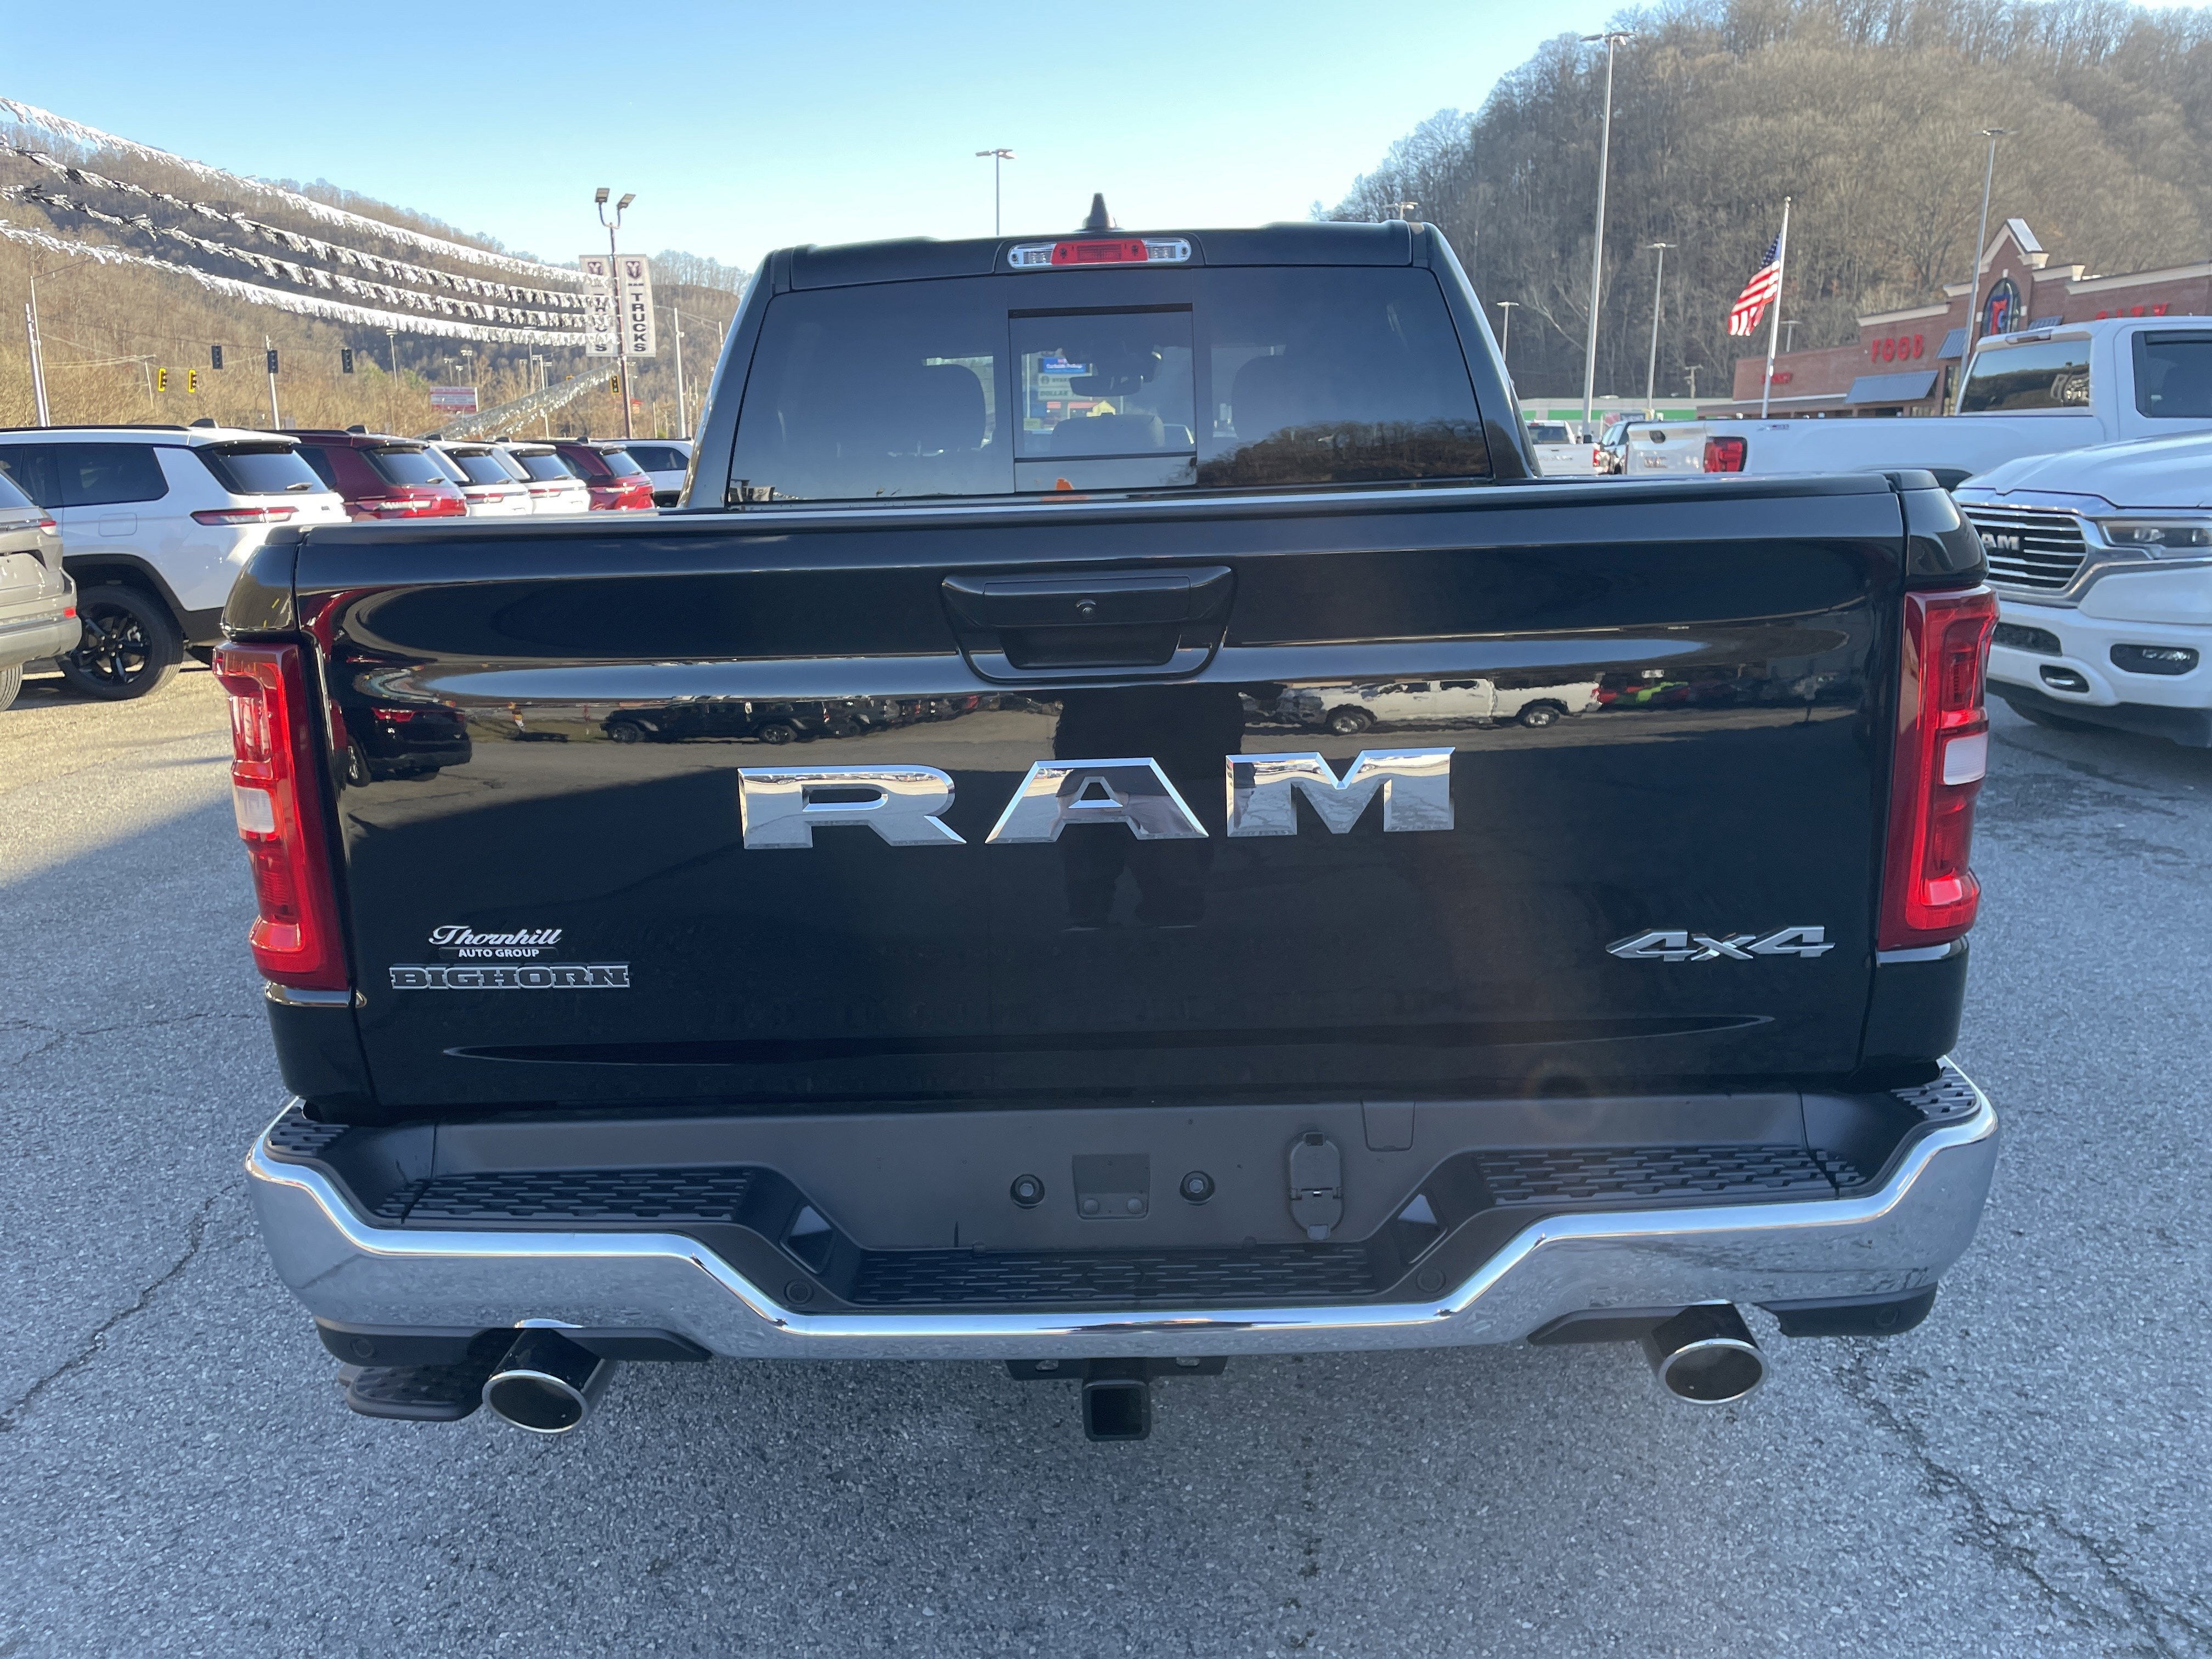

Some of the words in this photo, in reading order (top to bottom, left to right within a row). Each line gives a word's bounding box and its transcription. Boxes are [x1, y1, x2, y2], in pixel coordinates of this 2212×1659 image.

[631, 293, 646, 352] TRUCKS
[1871, 334, 1923, 363] FOOD
[1980, 533, 2019, 551] AM
[737, 747, 1457, 850] RAM
[428, 925, 562, 945] Thornhill
[1606, 926, 1836, 962] 4x4
[458, 949, 493, 957] AUTO
[495, 949, 540, 957] GROUP
[388, 964, 631, 989] BIGHORN
